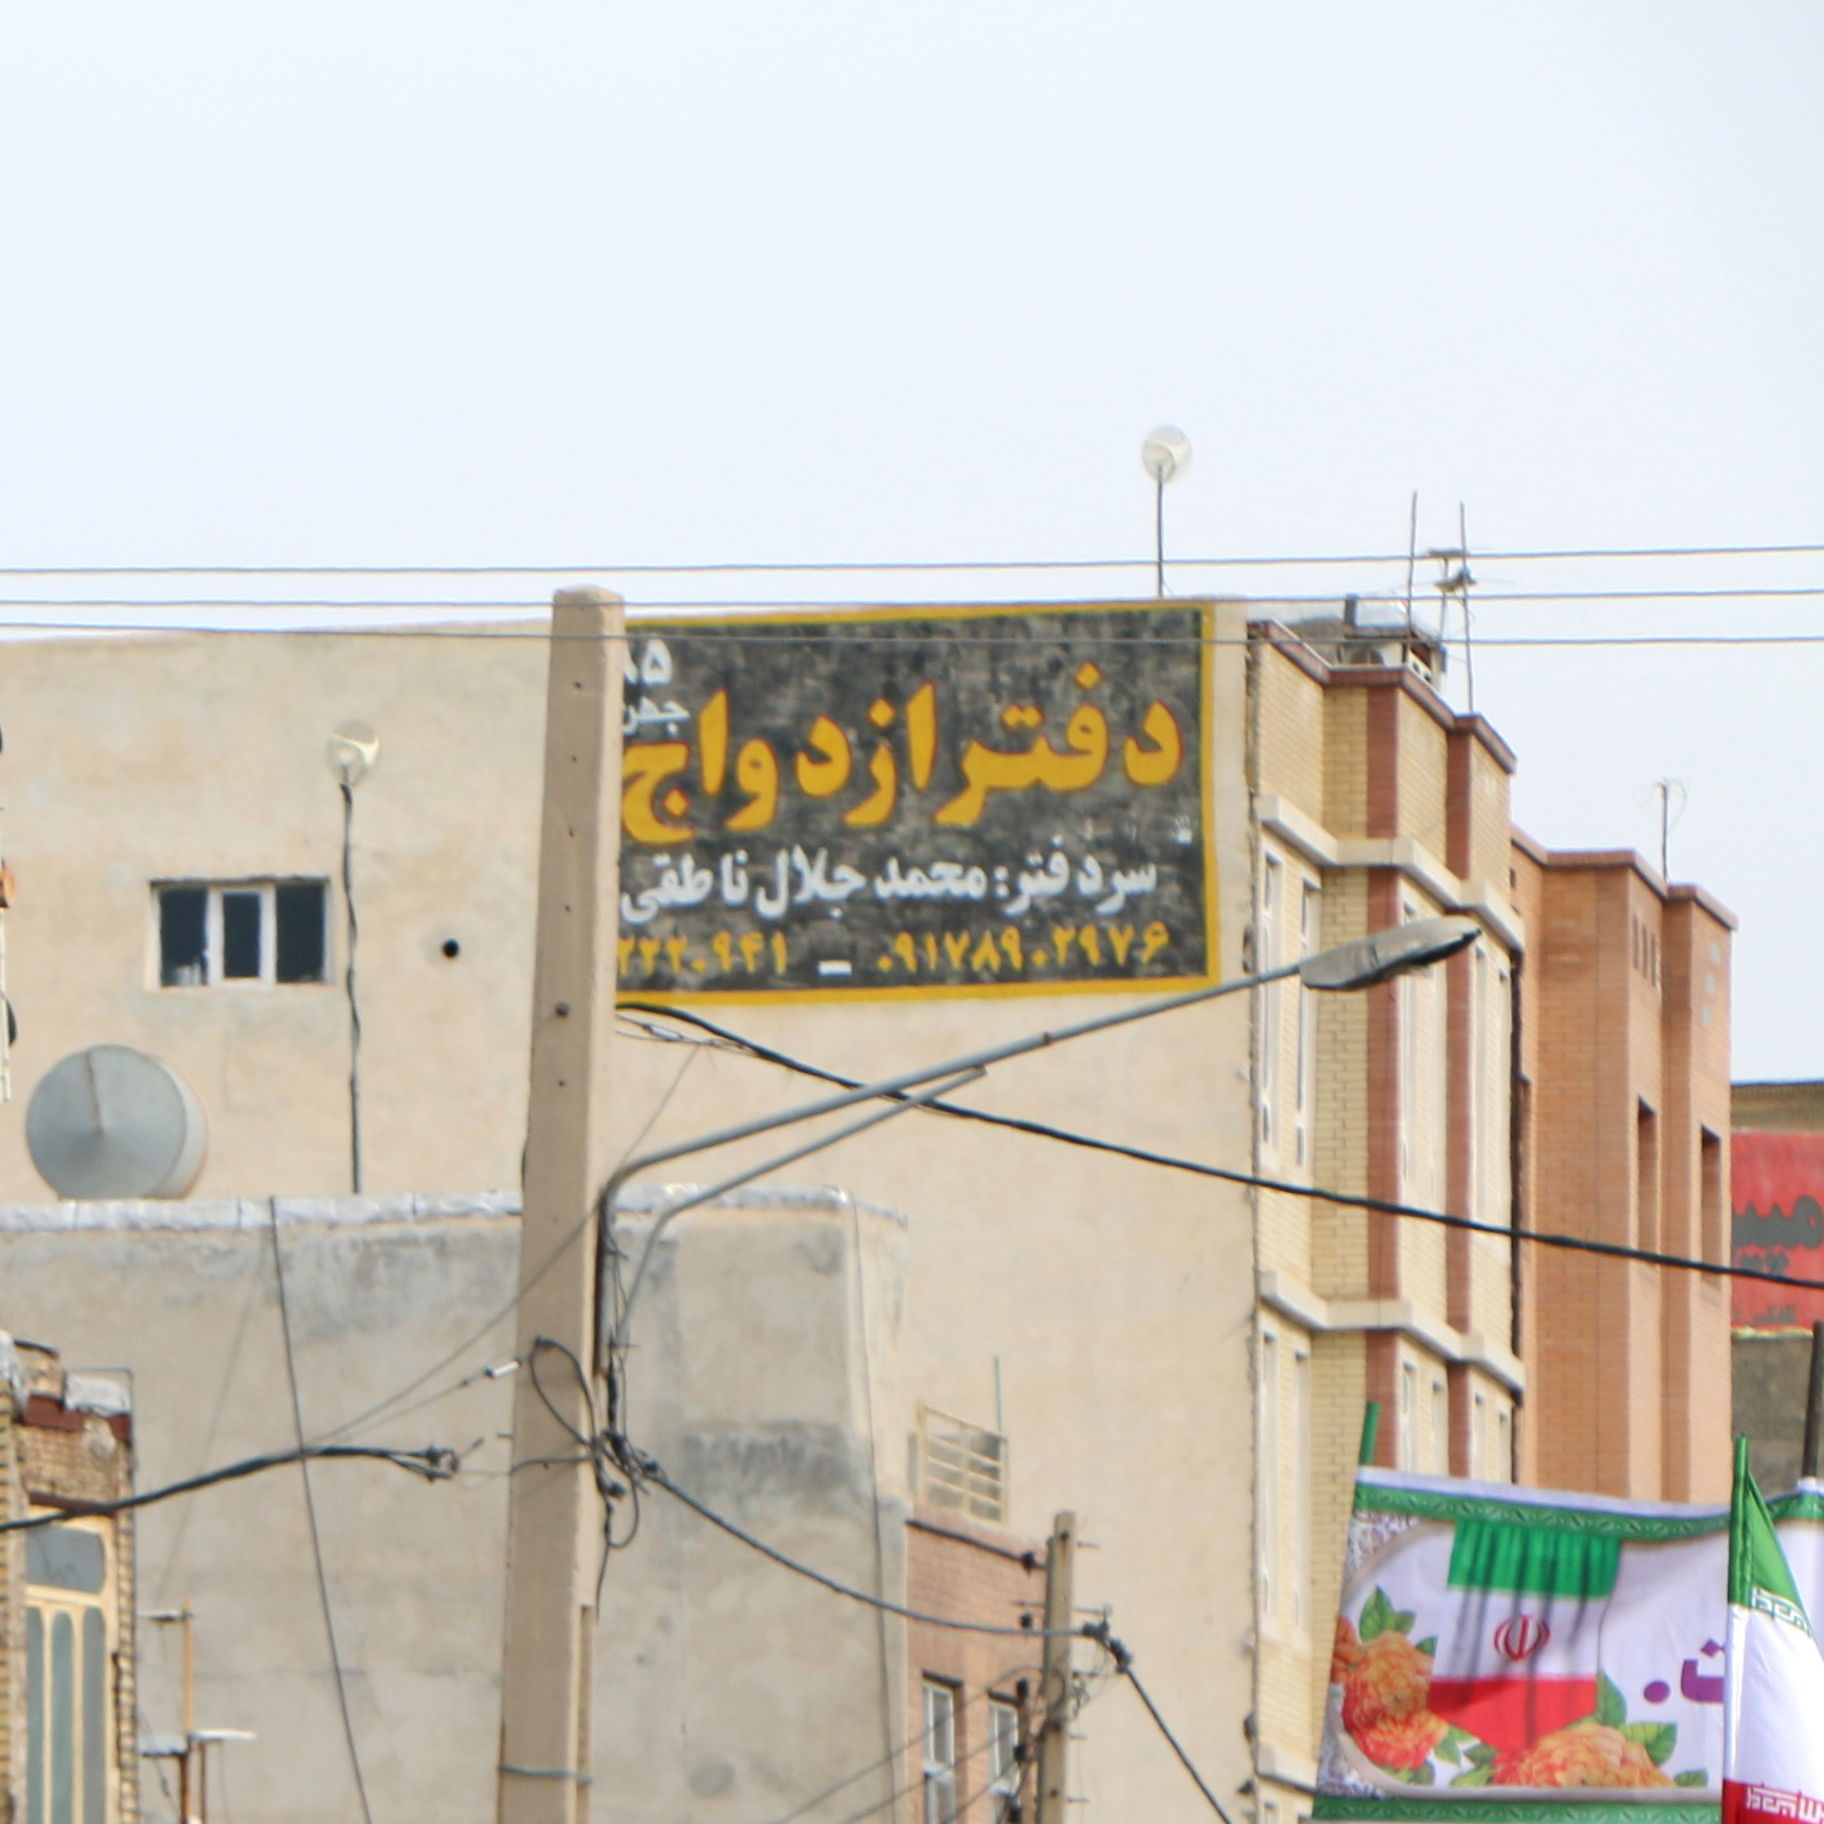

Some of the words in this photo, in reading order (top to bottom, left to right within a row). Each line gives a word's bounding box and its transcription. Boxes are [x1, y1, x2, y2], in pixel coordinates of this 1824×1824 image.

[621, 680, 936, 845] ازدواج
[933, 660, 1183, 827] دفتر
[621, 849, 750, 924] ناطقی
[754, 843, 866, 920] جلال
[874, 856, 989, 900] محمد
